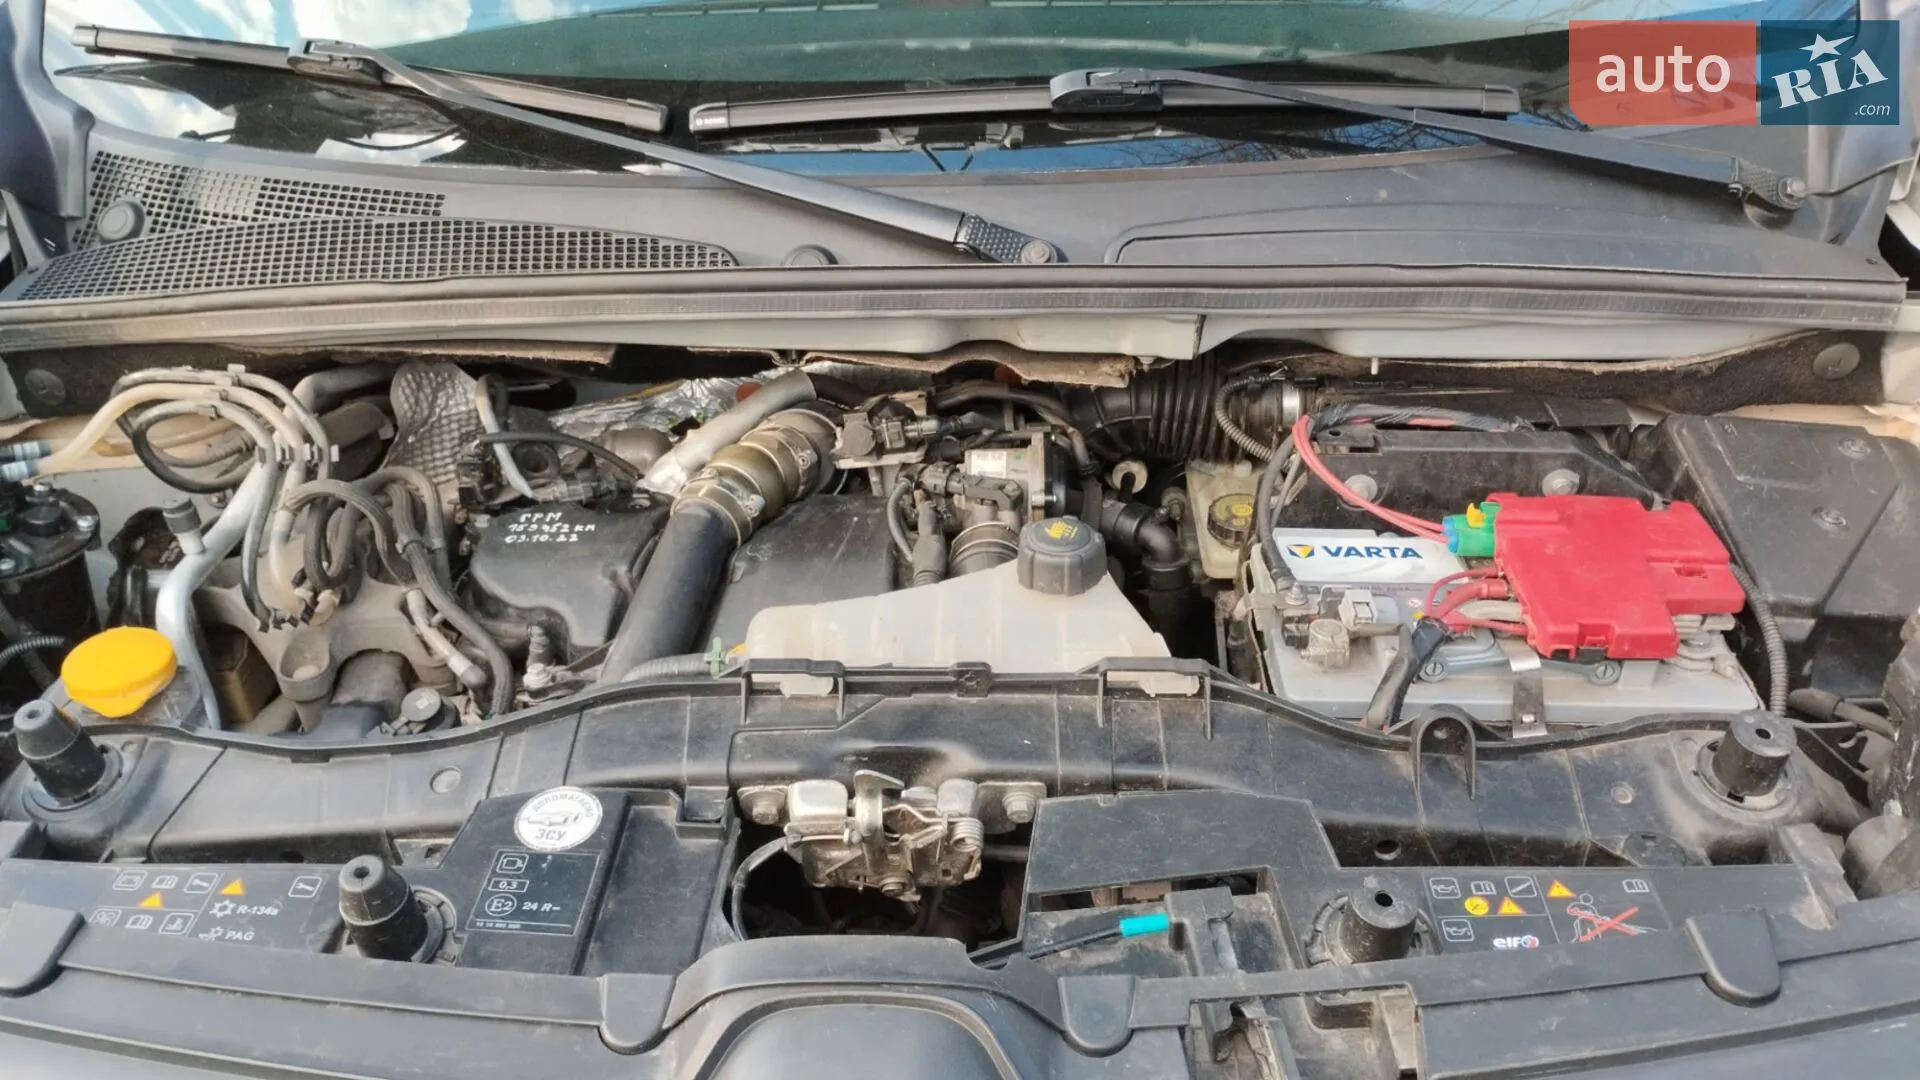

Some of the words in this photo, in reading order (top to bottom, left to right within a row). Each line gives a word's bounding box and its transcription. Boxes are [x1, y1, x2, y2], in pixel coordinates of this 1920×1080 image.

[1321, 545, 1423, 559] VARTA
[489, 898, 513, 912] E2
[522, 901, 539, 911] 24
[224, 929, 255, 941] PAG
